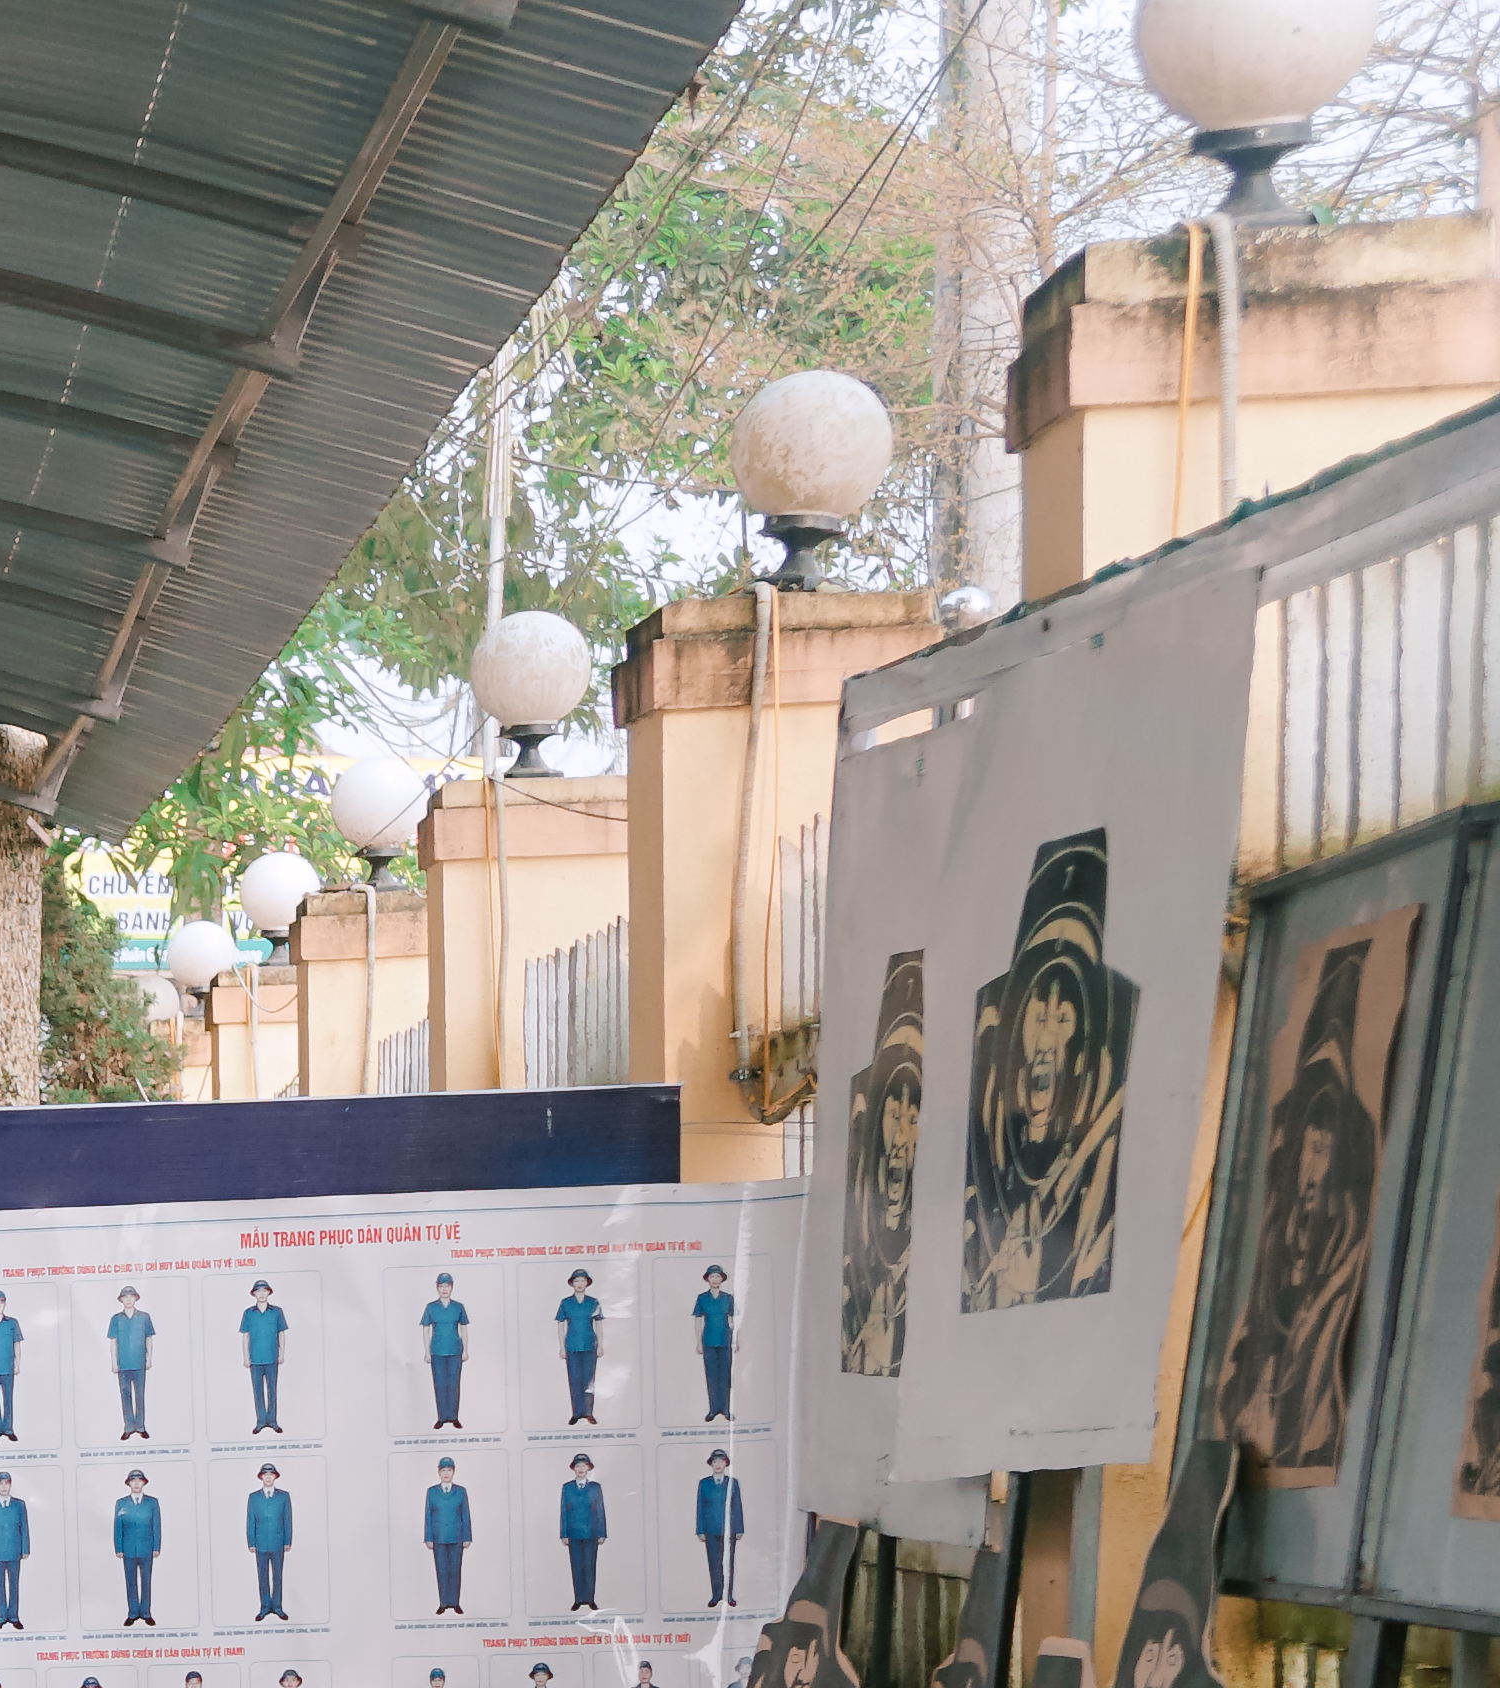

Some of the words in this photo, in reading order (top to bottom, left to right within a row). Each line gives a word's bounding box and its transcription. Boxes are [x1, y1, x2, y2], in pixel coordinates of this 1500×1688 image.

[273, 1230, 315, 1247] TRANG
[319, 1228, 353, 1248] PHỤC
[358, 1224, 382, 1244] DÂN
[386, 1222, 421, 1243] QUÂN
[425, 1224, 443, 1245] TỰ
[445, 1220, 461, 1244] VỆ
